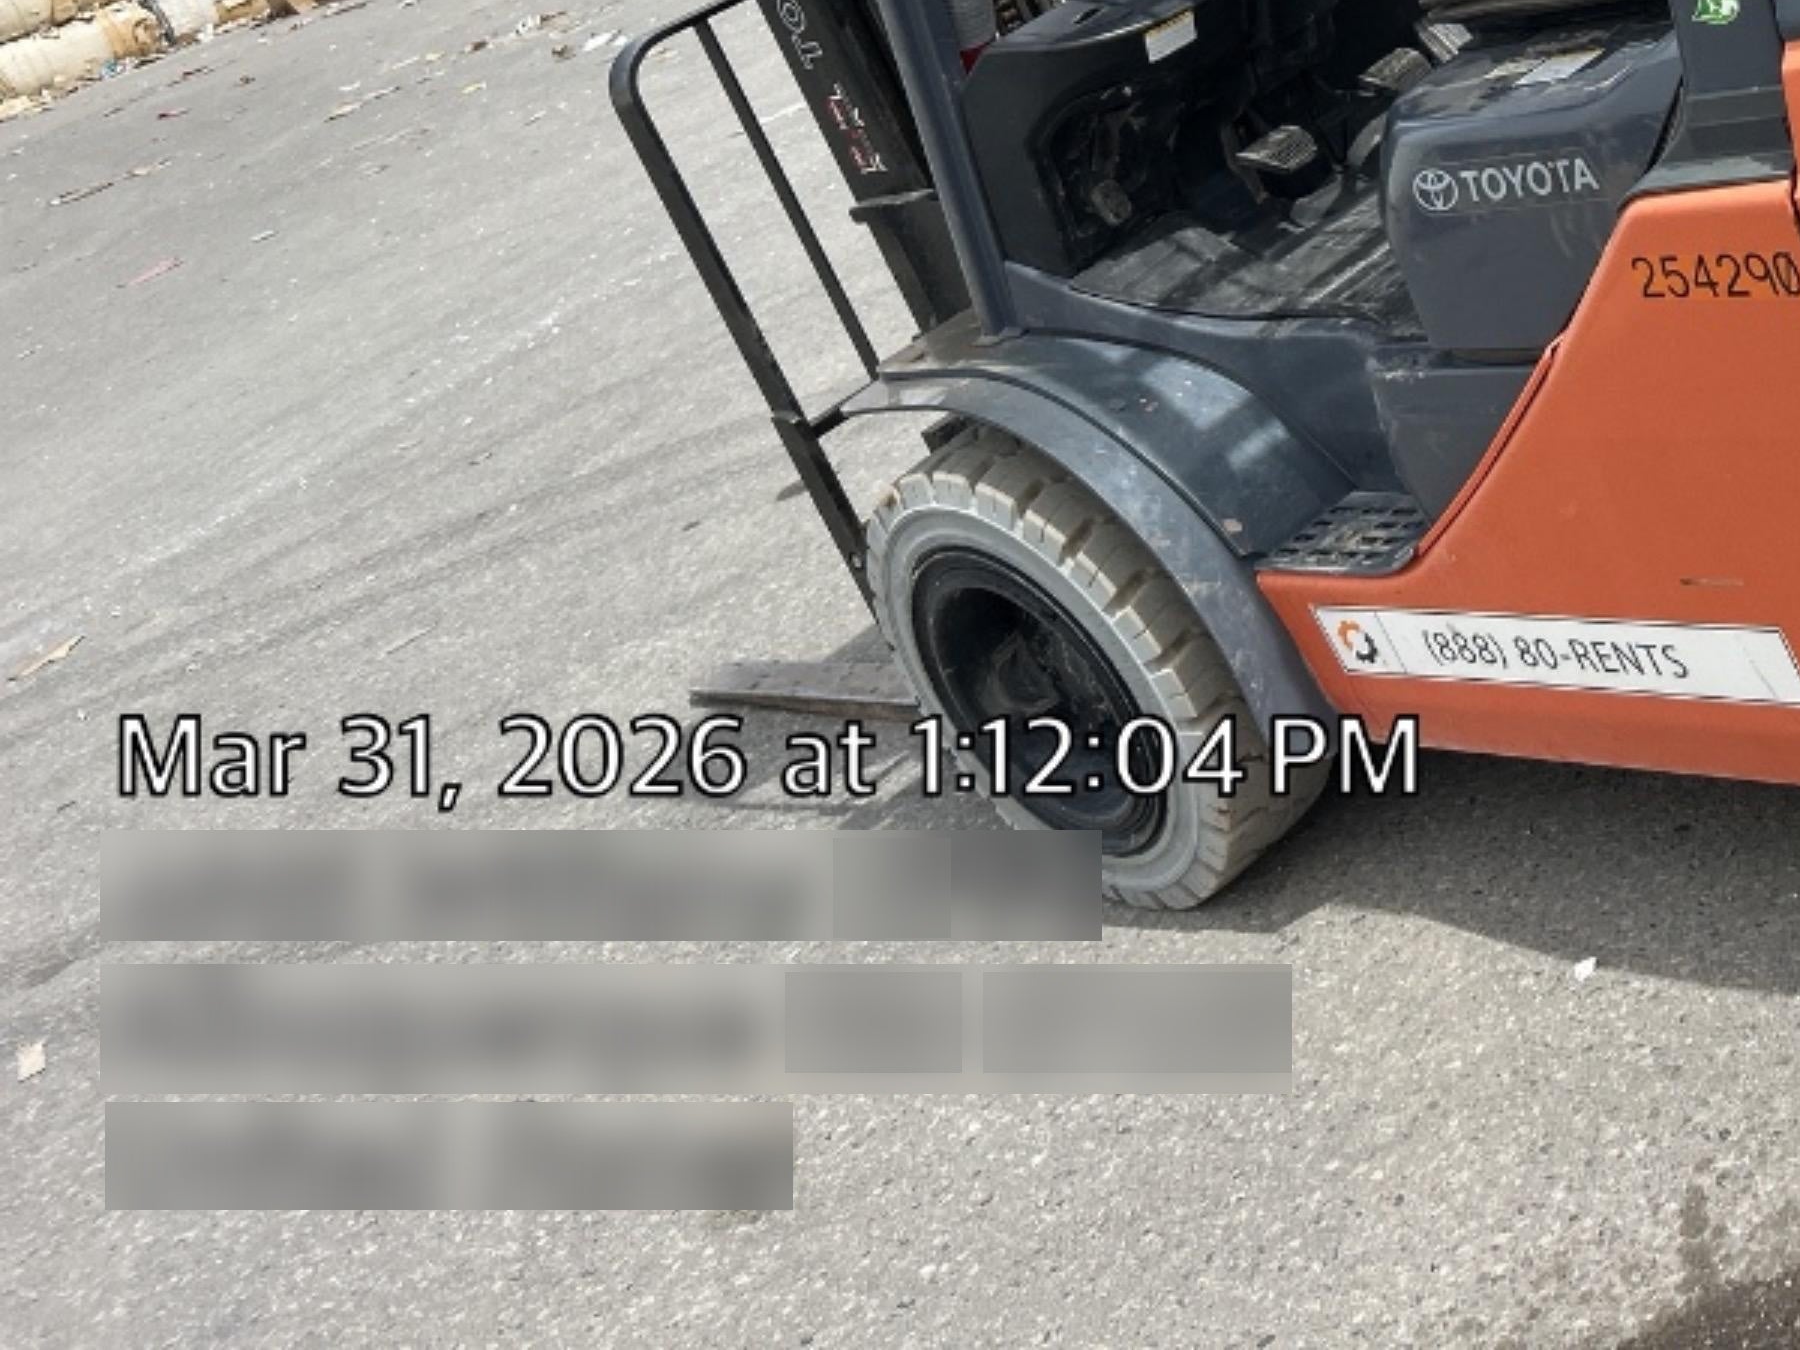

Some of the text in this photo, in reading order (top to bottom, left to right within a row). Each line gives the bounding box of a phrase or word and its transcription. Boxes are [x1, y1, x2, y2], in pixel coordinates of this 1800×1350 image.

[1461, 158, 1600, 202] TOYOTA
[1422, 629, 1690, 679] (888) 80-RENTS
